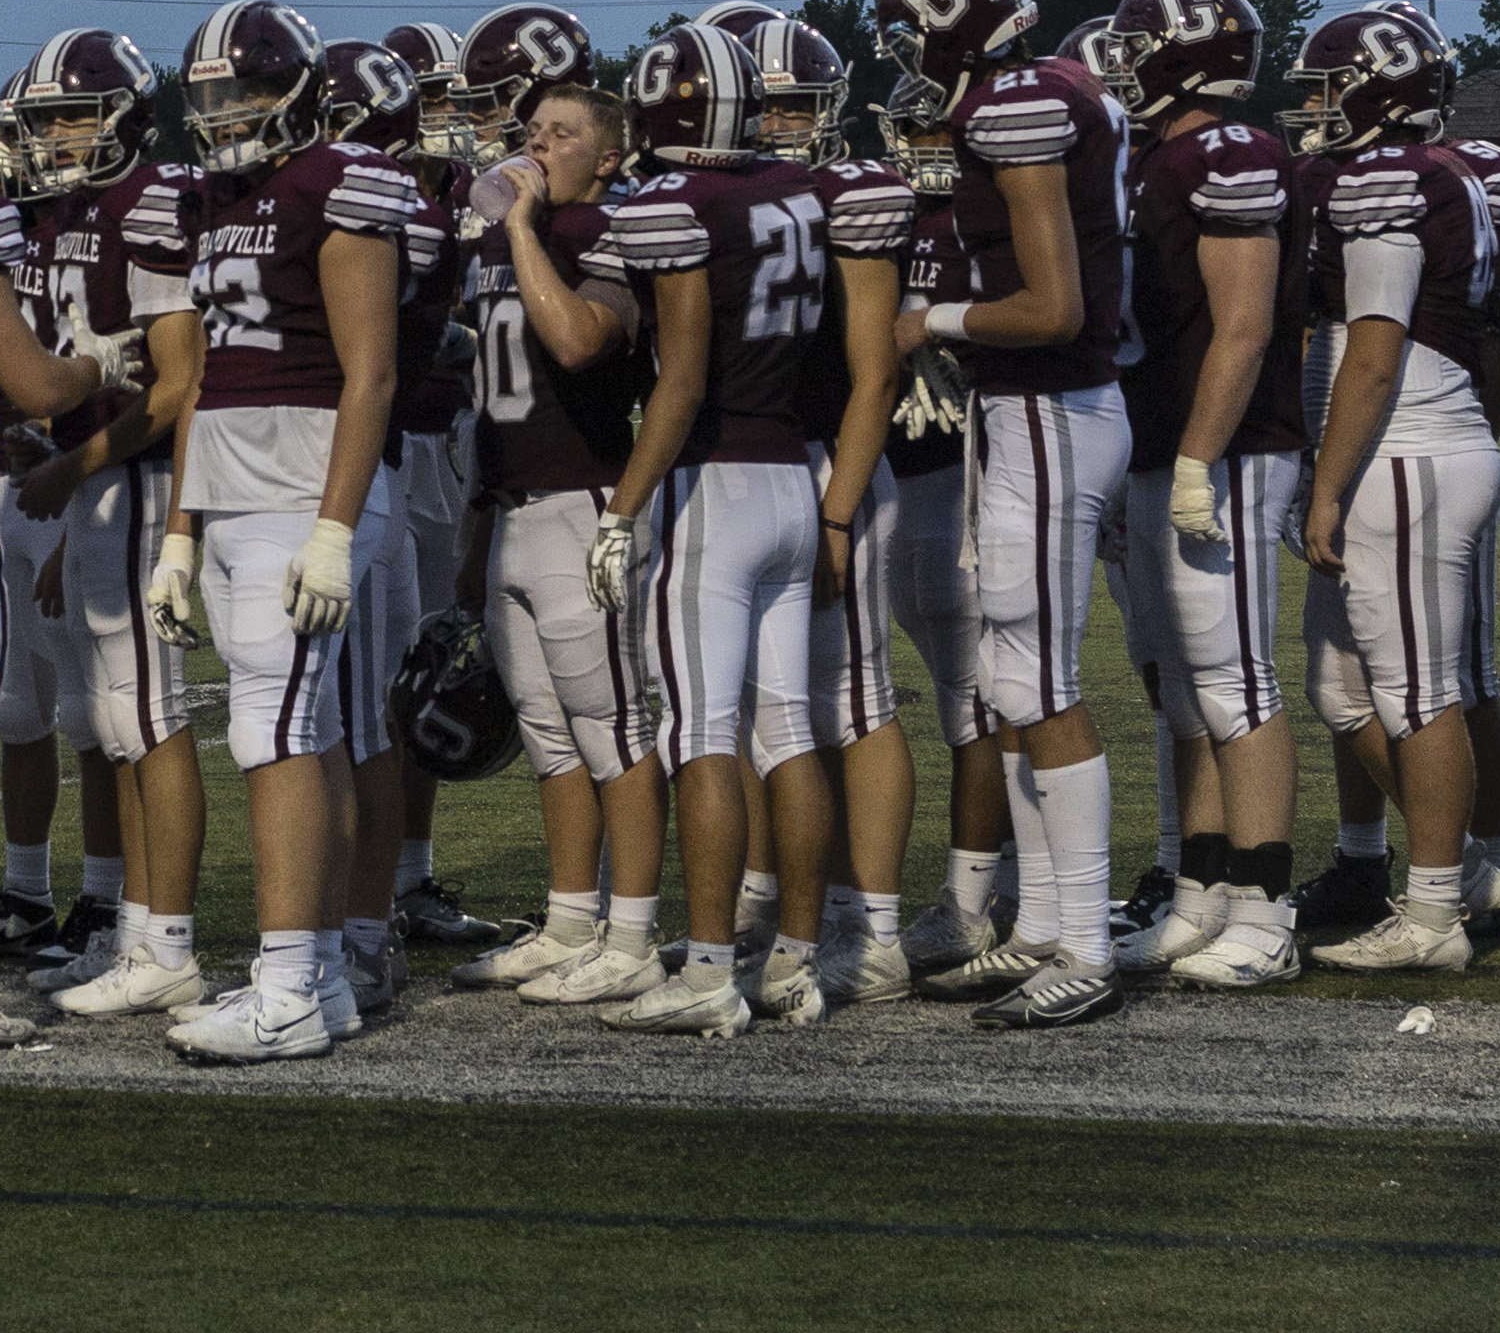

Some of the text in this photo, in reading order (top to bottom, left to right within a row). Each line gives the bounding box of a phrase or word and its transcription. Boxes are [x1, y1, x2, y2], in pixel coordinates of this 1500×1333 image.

[514, 15, 581, 81] G
[637, 40, 680, 108] G
[993, 68, 1040, 93] 21
[1358, 20, 1420, 81] G
[353, 50, 414, 117] G
[742, 190, 828, 342] 25
